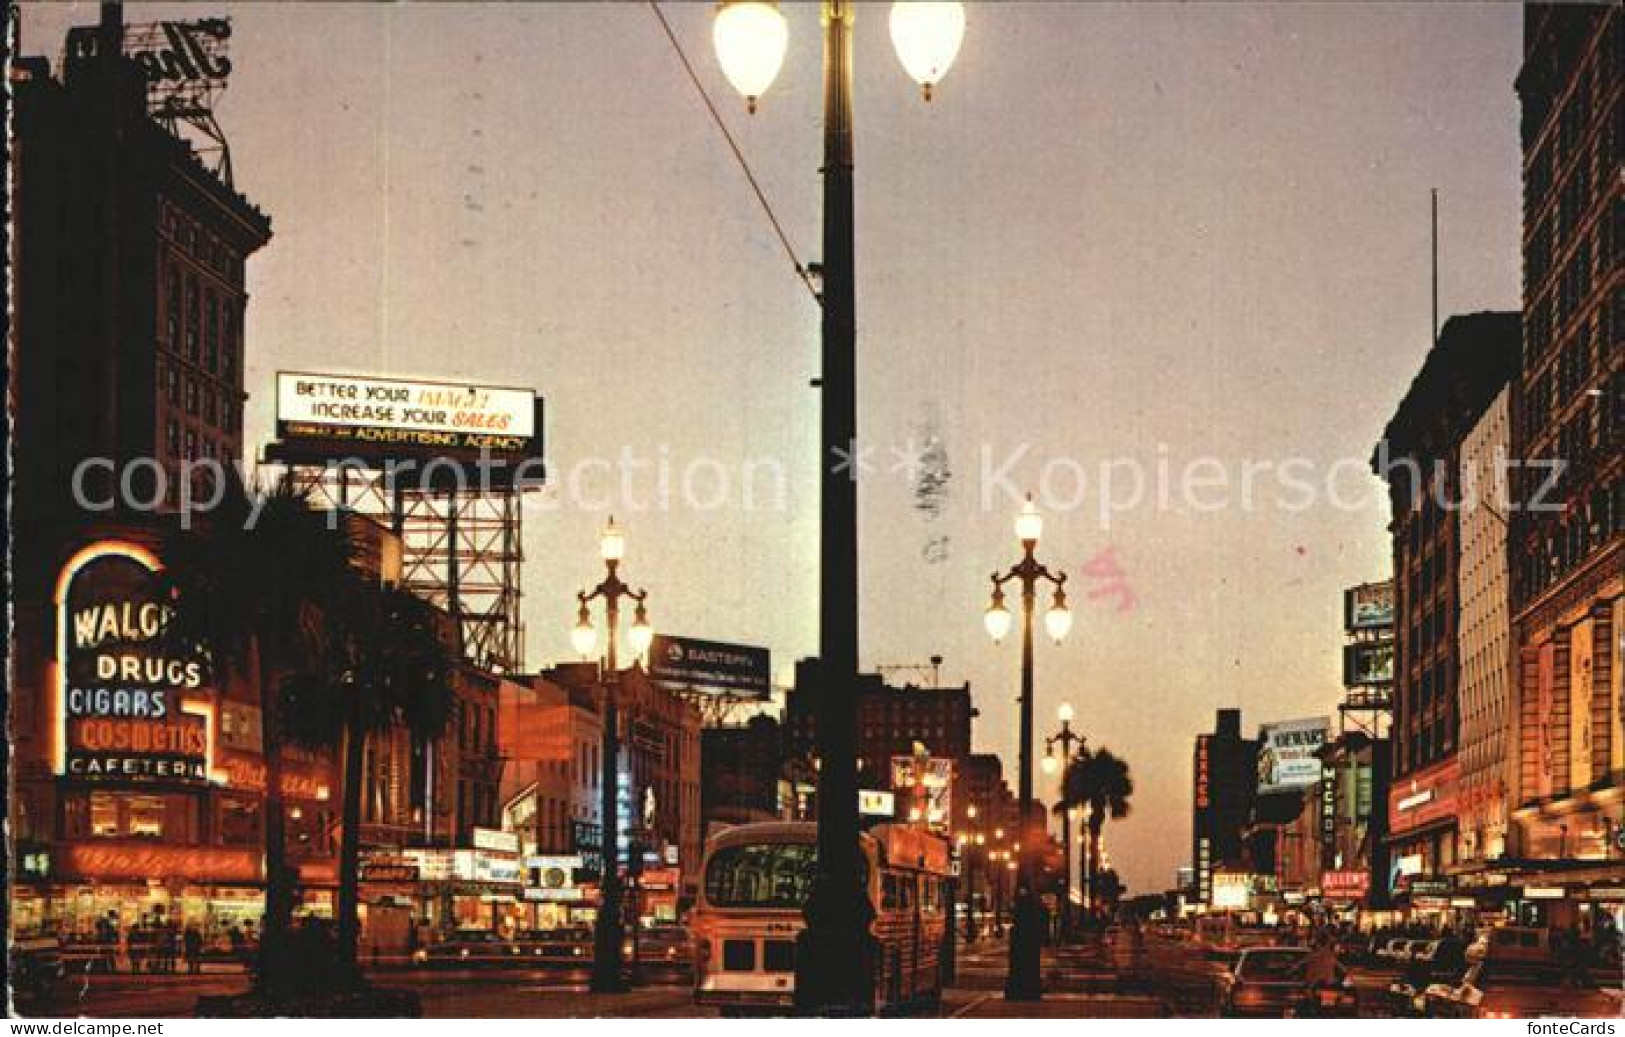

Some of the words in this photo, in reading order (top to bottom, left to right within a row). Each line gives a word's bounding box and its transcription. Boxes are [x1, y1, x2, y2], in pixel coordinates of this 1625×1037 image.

[296, 380, 359, 400] BETTER
[365, 386, 410, 402] YOUR
[311, 402, 395, 422] INCREASE
[401, 408, 447, 426] YOUR
[451, 410, 513, 430] SALES
[355, 426, 460, 447] ADVERTISING
[465, 435, 527, 451] AGENCY
[97, 654, 201, 688] DRUGS
[69, 688, 166, 717] CIGARS
